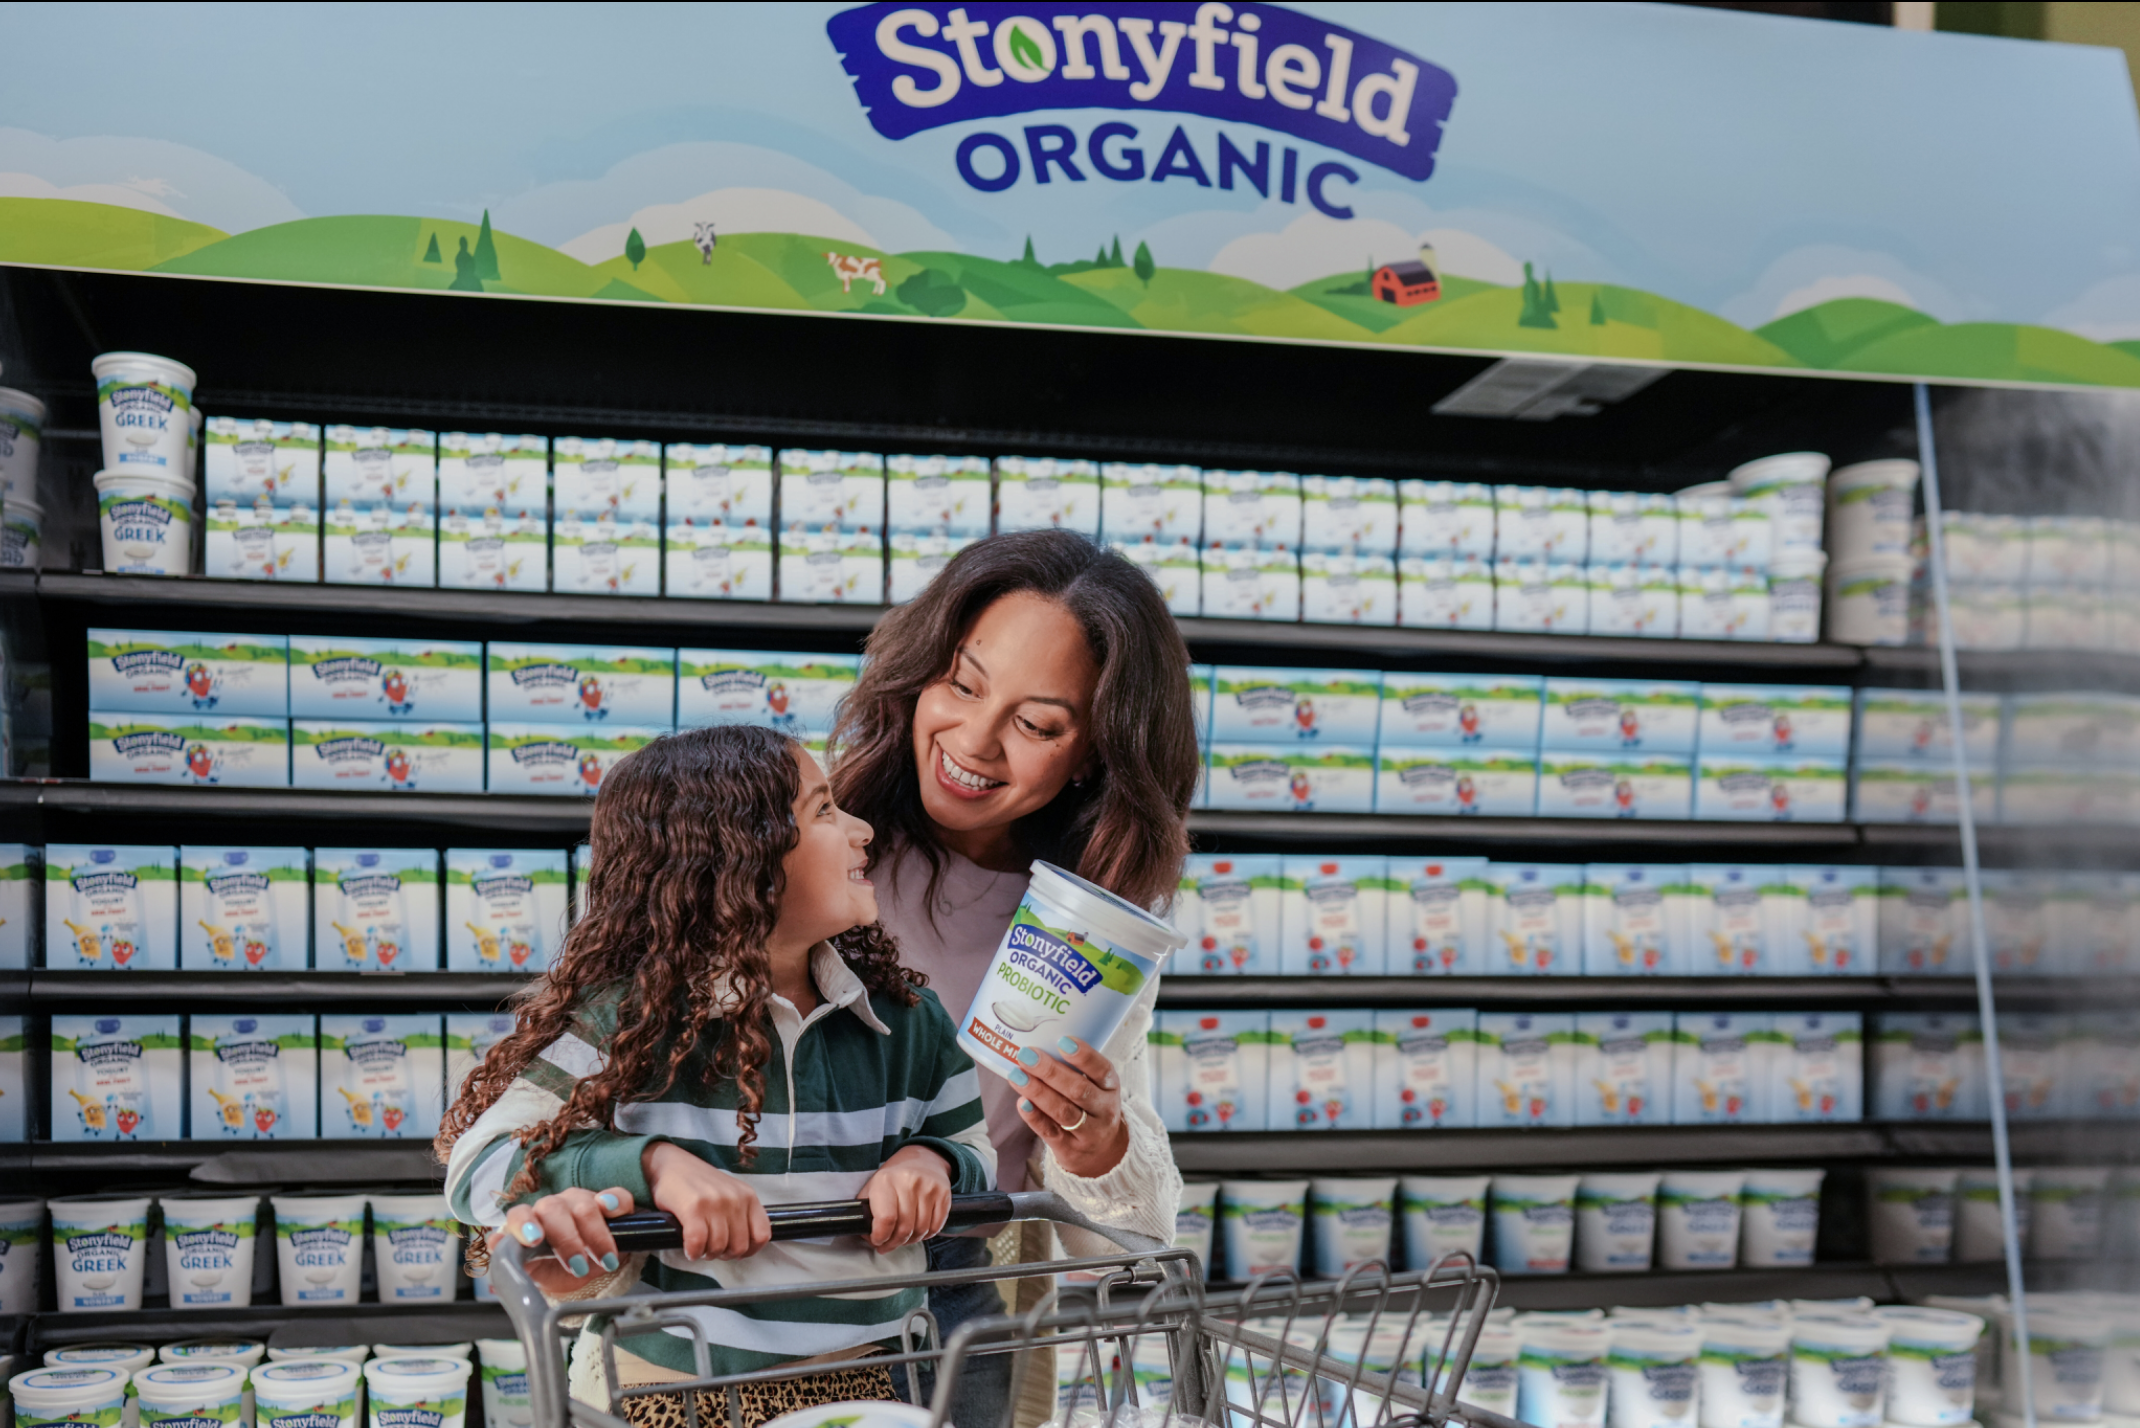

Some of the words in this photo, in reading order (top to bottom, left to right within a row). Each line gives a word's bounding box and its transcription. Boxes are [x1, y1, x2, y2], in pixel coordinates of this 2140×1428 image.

[875, 2, 1419, 146] Stonyfield
[955, 121, 1360, 220] ORGANIC
[115, 413, 168, 432] GREEK
[114, 526, 166, 544] GREEK
[116, 650, 180, 670] Stonyfield
[117, 732, 181, 752] Stonyfield
[76, 873, 135, 890] Stonyfield
[1011, 925, 1096, 987] Stonyfield
[1010, 951, 1072, 995] ORGANIC
[997, 961, 1071, 1015] PROBIOTIC
[973, 1022, 1003, 1050] WHOLE
[1002, 1044, 1019, 1060] MI
[995, 1024, 1014, 1040] PLAIN
[82, 1042, 139, 1059] Stonyfield
[69, 1233, 132, 1250] Stonyfield
[177, 1231, 237, 1249] Stonyfield
[72, 1257, 127, 1272] GREEK
[180, 1254, 233, 1269] GREEK
[295, 1251, 346, 1267] GREEK
[393, 1249, 443, 1265] GREEK
[273, 1414, 338, 1428] Stonyfield
[379, 1409, 440, 1427] Stonyfield
